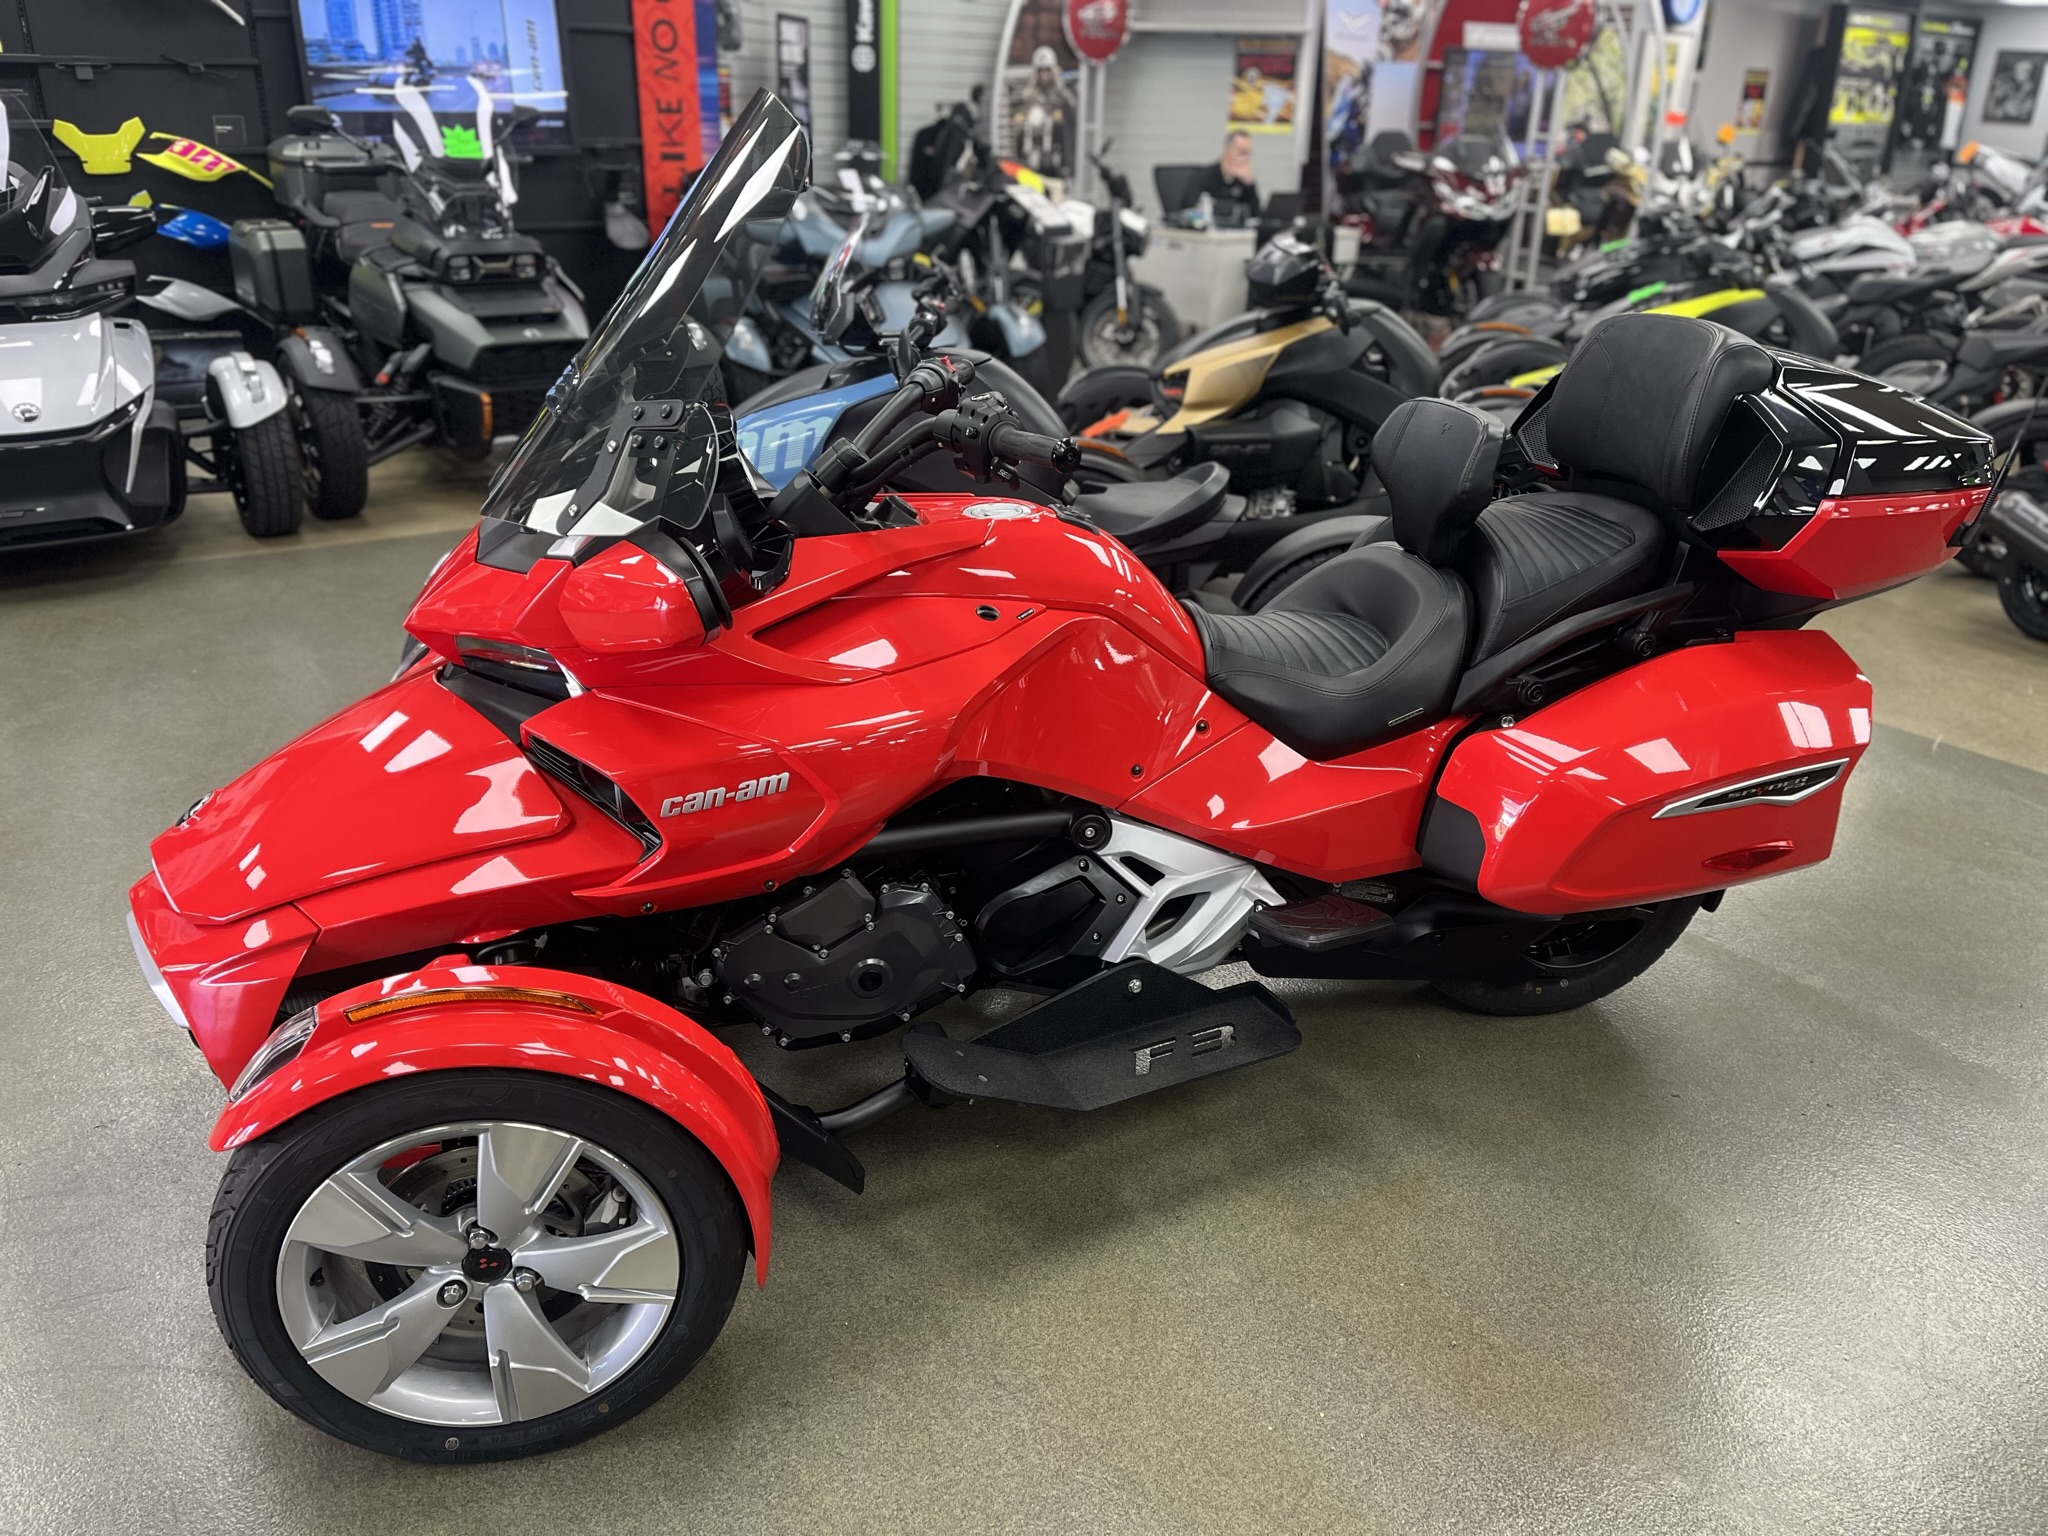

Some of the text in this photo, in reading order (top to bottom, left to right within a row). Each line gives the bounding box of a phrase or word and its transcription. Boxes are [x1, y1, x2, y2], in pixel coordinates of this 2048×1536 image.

[651, 18, 682, 83] NO
[659, 771, 791, 819] can-am
[1727, 775, 1809, 799] SPYDER
[1128, 1022, 1237, 1077] F3
